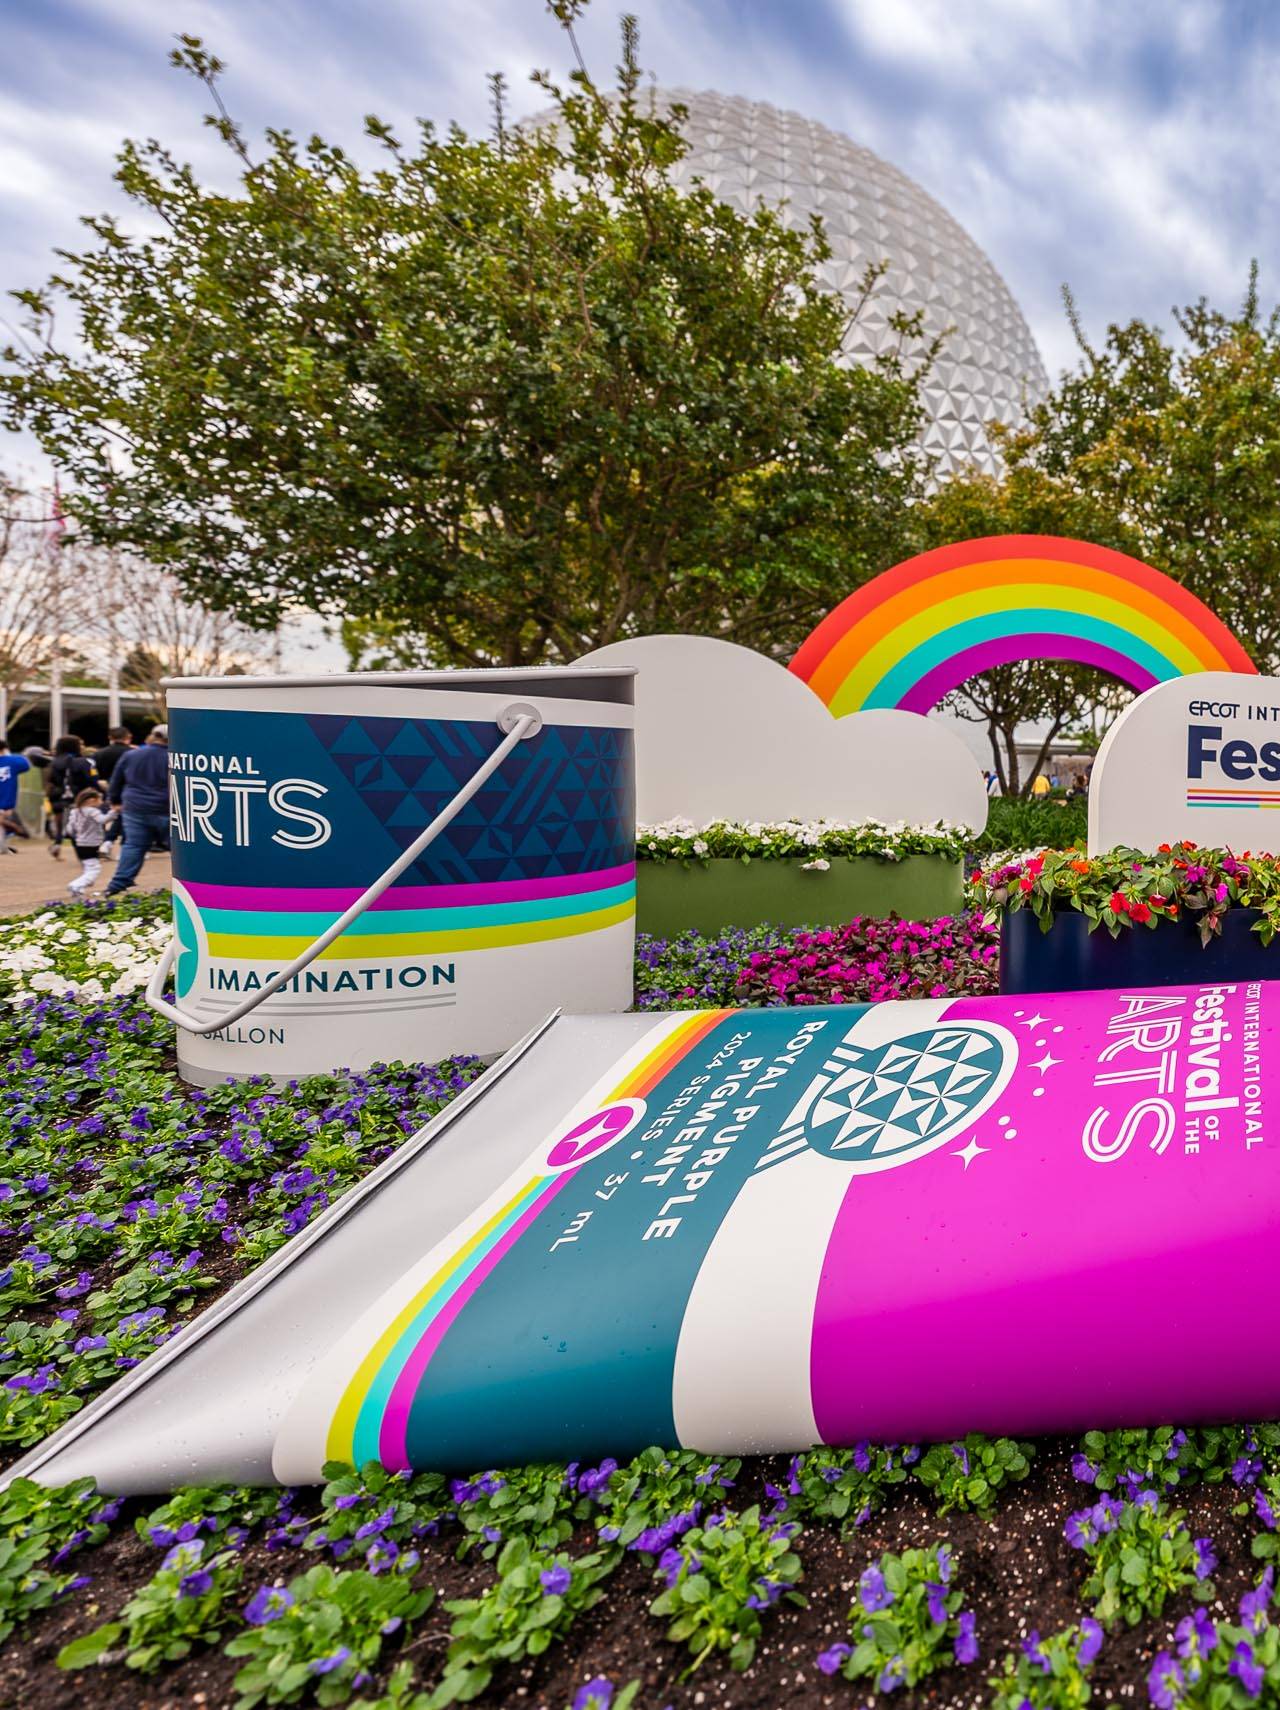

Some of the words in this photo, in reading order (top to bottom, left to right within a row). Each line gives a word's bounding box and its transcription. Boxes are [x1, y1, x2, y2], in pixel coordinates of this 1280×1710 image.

[1189, 701, 1240, 718] EPCOT
[169, 774, 332, 850] ARTS
[704, 1031, 752, 1070] 2024
[745, 1020, 829, 1099] ROYAL
[1081, 995, 1188, 1163] ARTS
[1184, 985, 1240, 1113] Festival
[1244, 1001, 1265, 1151] INTERNATIONAL
[641, 1074, 712, 1142] SERIES
[641, 1056, 764, 1187] PIGMENT
[1184, 1117, 1200, 1155] THE
[1204, 1115, 1219, 1141] OF
[594, 1171, 630, 1201] 37
[641, 1104, 761, 1241] PURPLE
